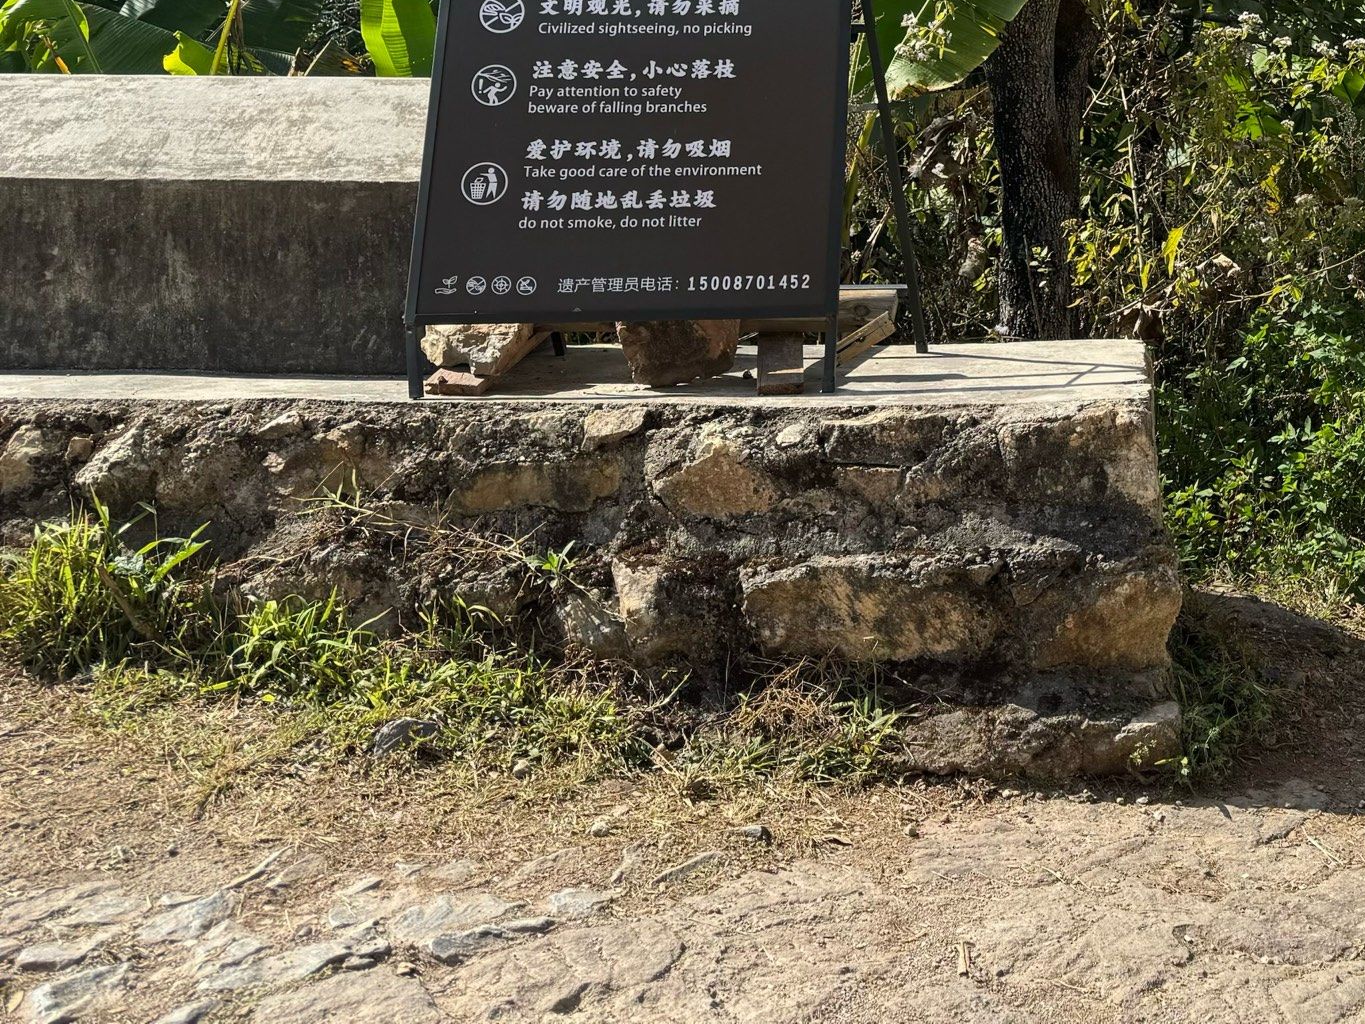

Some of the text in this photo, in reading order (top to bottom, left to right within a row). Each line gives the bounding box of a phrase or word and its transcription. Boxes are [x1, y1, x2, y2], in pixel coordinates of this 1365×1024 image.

[538, 21, 753, 37] Civilized sightseeing, no picking
[532, 58, 737, 82] 注意安全，小心落枝
[529, 84, 683, 100] Pay attention to safety
[527, 100, 708, 117] beware of falling branches
[524, 138, 732, 162] 爱护环境，请勿吸烟
[523, 164, 763, 181] Take good care of the environment
[520, 189, 717, 212] 请勿随地乱丢垃圾
[518, 214, 703, 230] do not smoke, do not litter
